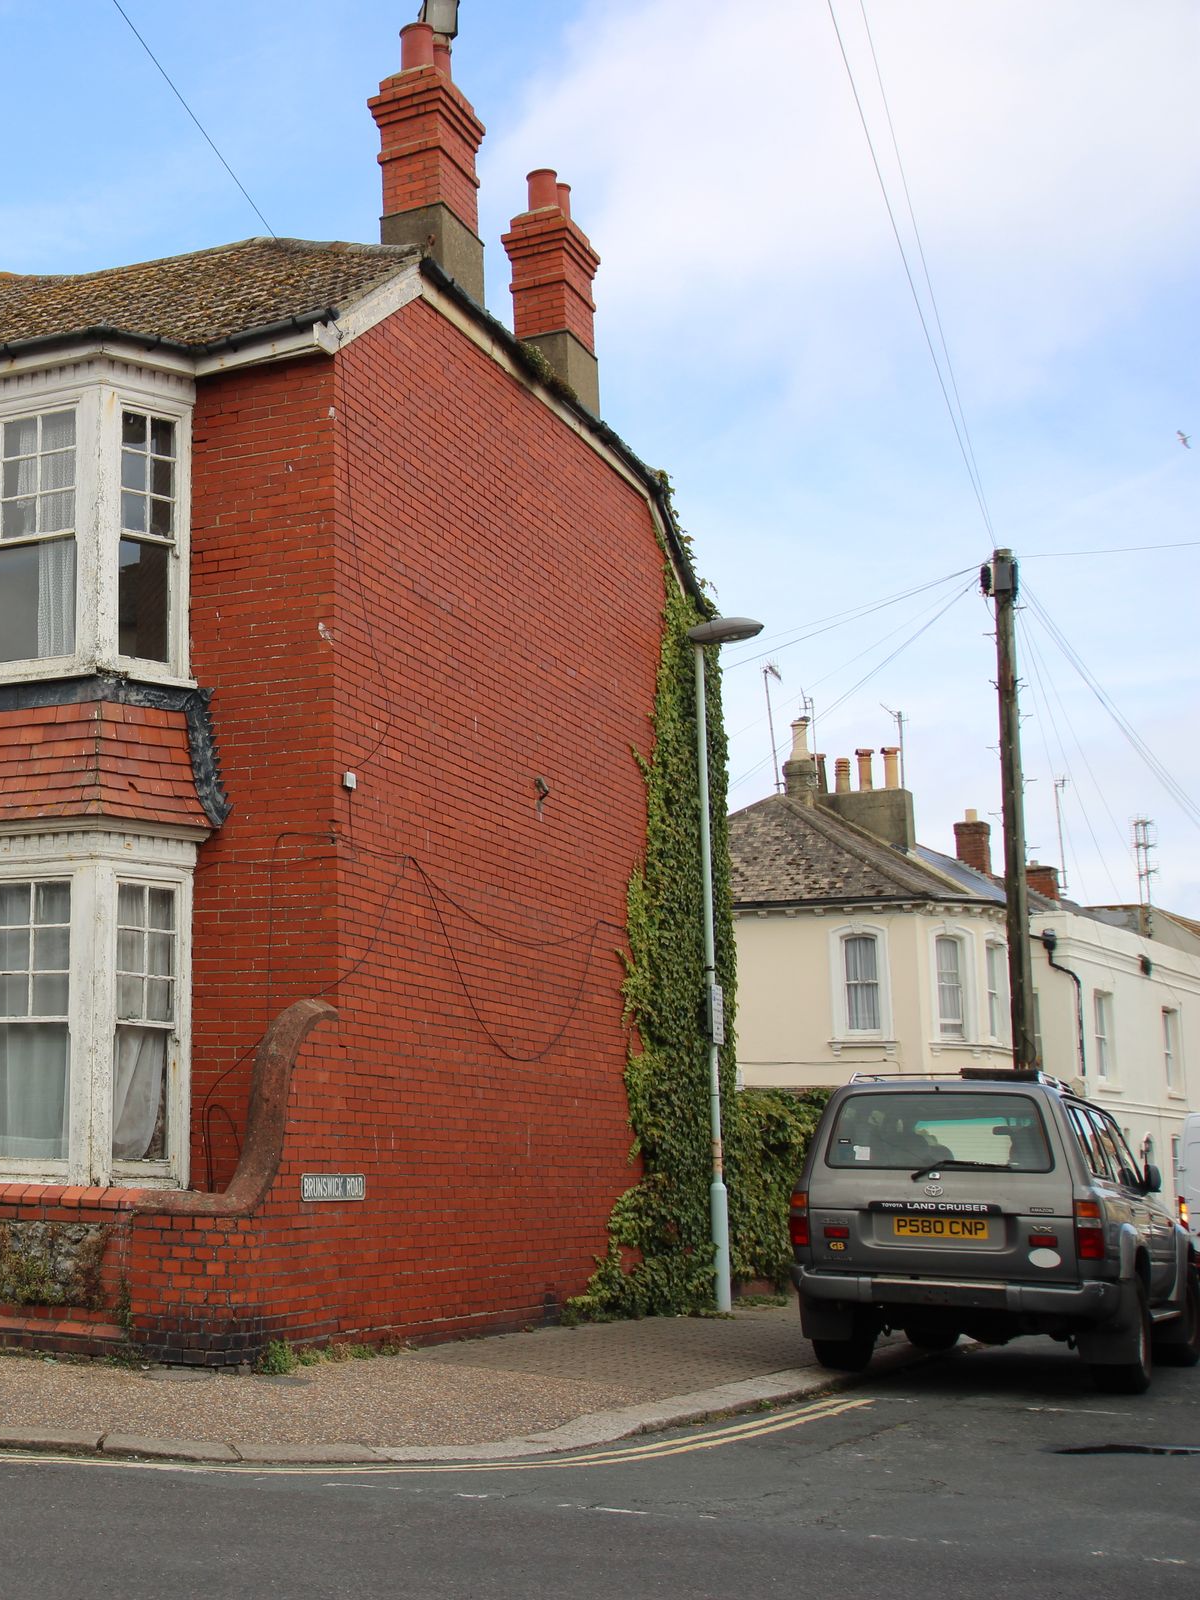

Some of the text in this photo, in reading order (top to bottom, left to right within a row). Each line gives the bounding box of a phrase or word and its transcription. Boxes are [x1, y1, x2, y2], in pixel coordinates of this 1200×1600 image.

[304, 1177, 363, 1197] BRUNSWICK ROAD
[907, 1202, 936, 1210] LAND
[938, 1203, 988, 1212] CRUISER
[896, 1219, 986, 1235] P580 CNP
[830, 1242, 846, 1250] GB
